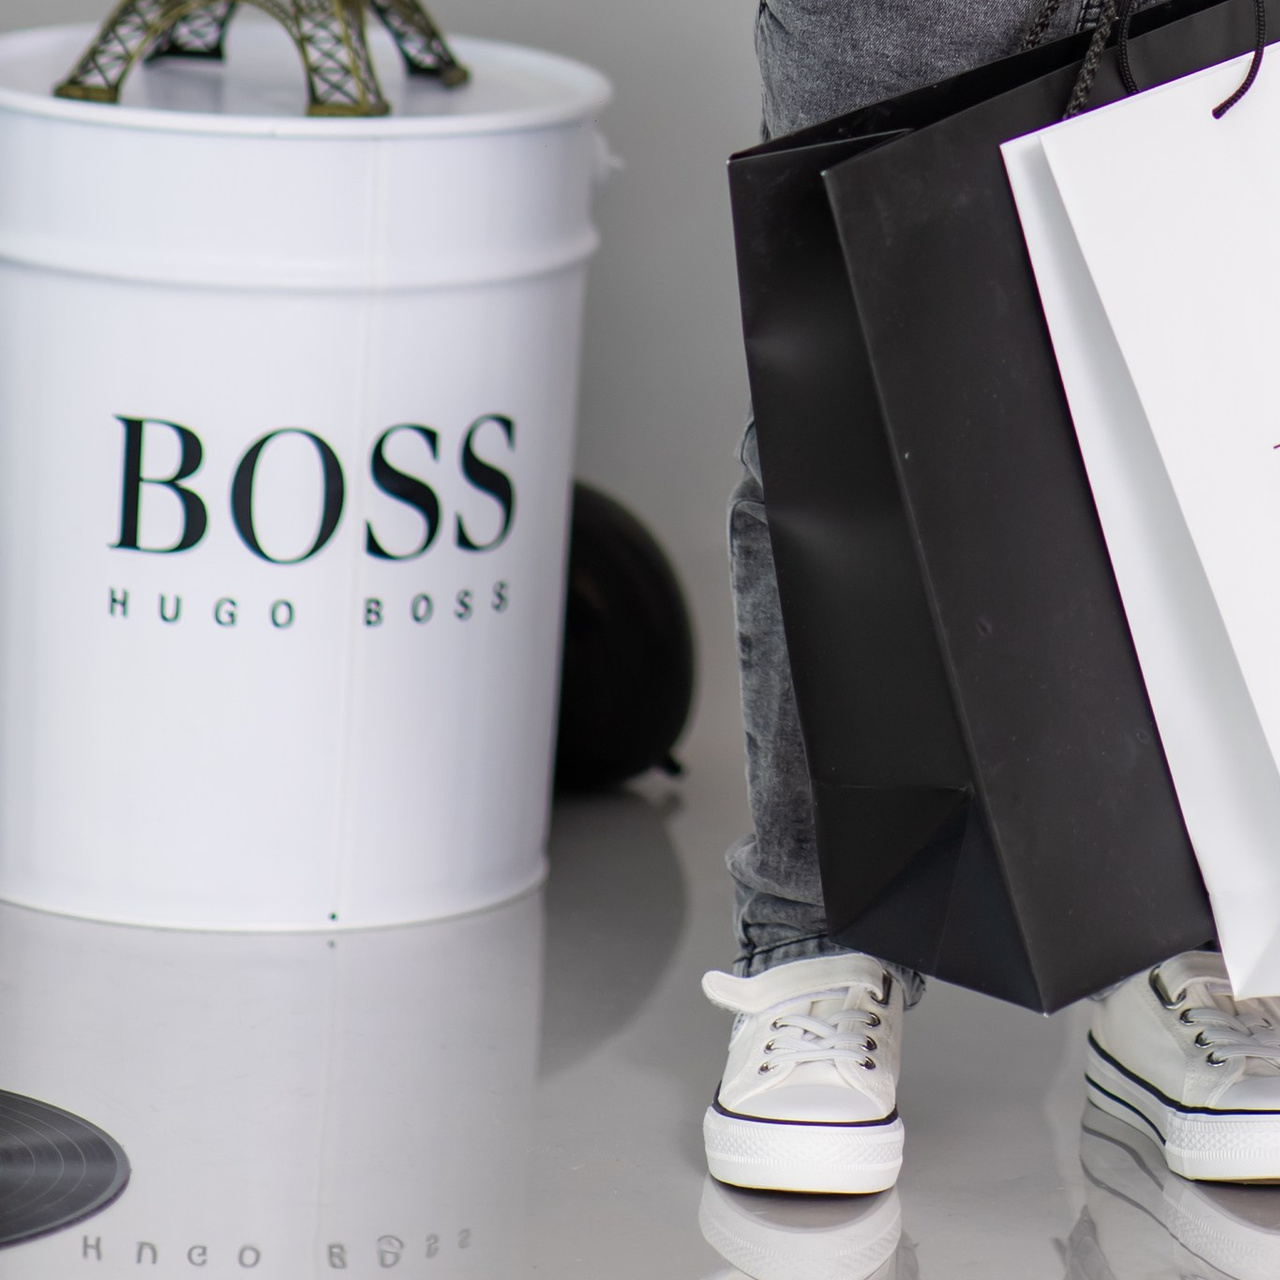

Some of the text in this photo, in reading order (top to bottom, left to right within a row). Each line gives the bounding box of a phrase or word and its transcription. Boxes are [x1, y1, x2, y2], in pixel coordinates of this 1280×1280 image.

[107, 413, 516, 565] BOSS
[108, 579, 510, 629] HUGO BOSS
